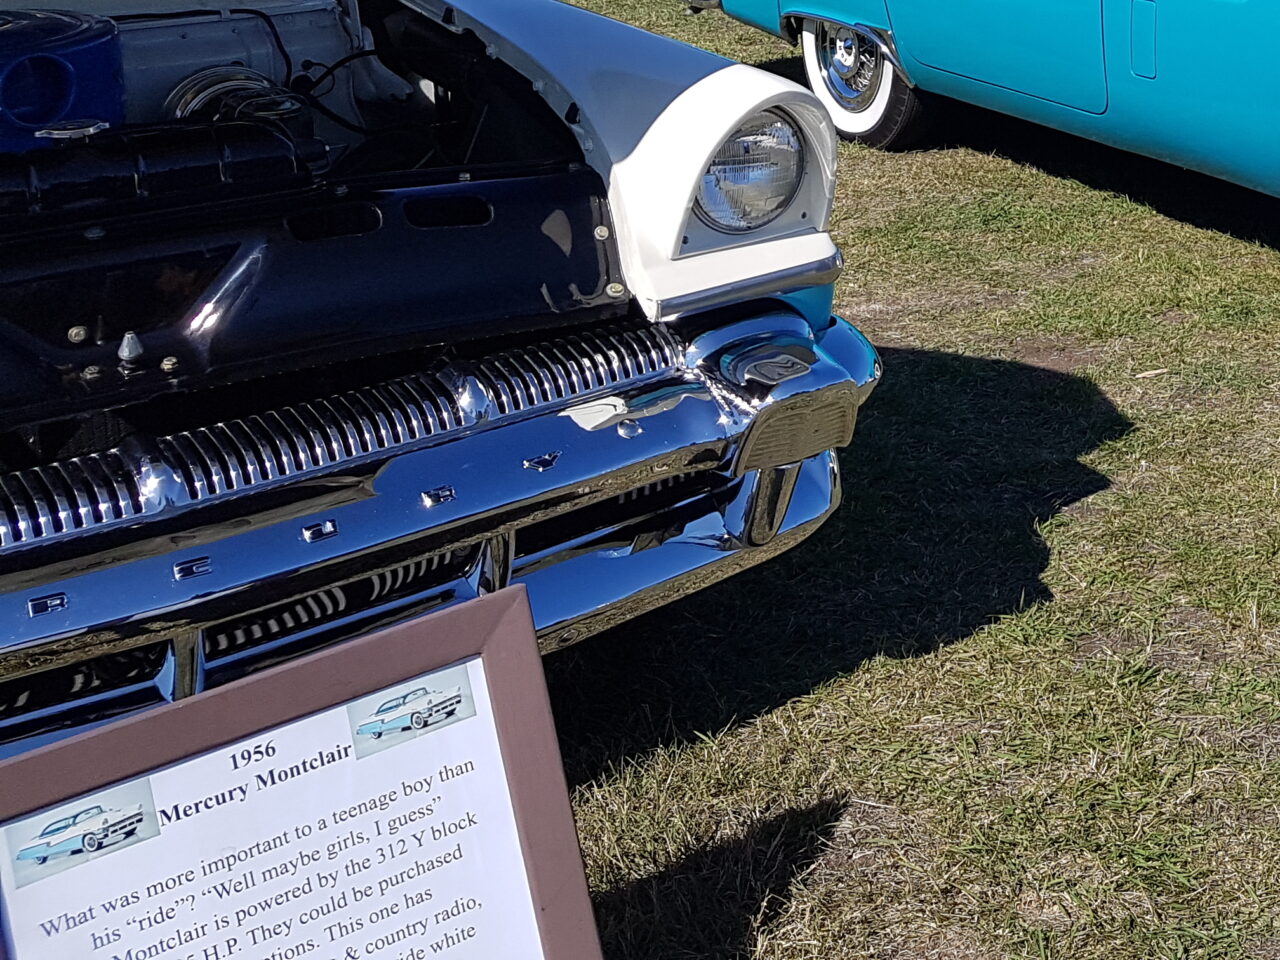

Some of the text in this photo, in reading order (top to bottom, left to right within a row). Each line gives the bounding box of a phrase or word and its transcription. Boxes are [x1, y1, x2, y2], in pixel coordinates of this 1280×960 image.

[158, 744, 353, 827] Mercury Montclair
[229, 739, 277, 772] 1956
[39, 760, 475, 938] What was more important to a teenage boy than
[90, 795, 442, 952] his “ride”? “Well maybe girls, I guess”
[112, 811, 478, 960] Montclair is powered by the 312 Y block
[201, 843, 464, 960] H.P. They could be purchased
[263, 888, 433, 960] tions. This one has
[344, 896, 483, 960] & country radio,
[430, 925, 477, 954] white
